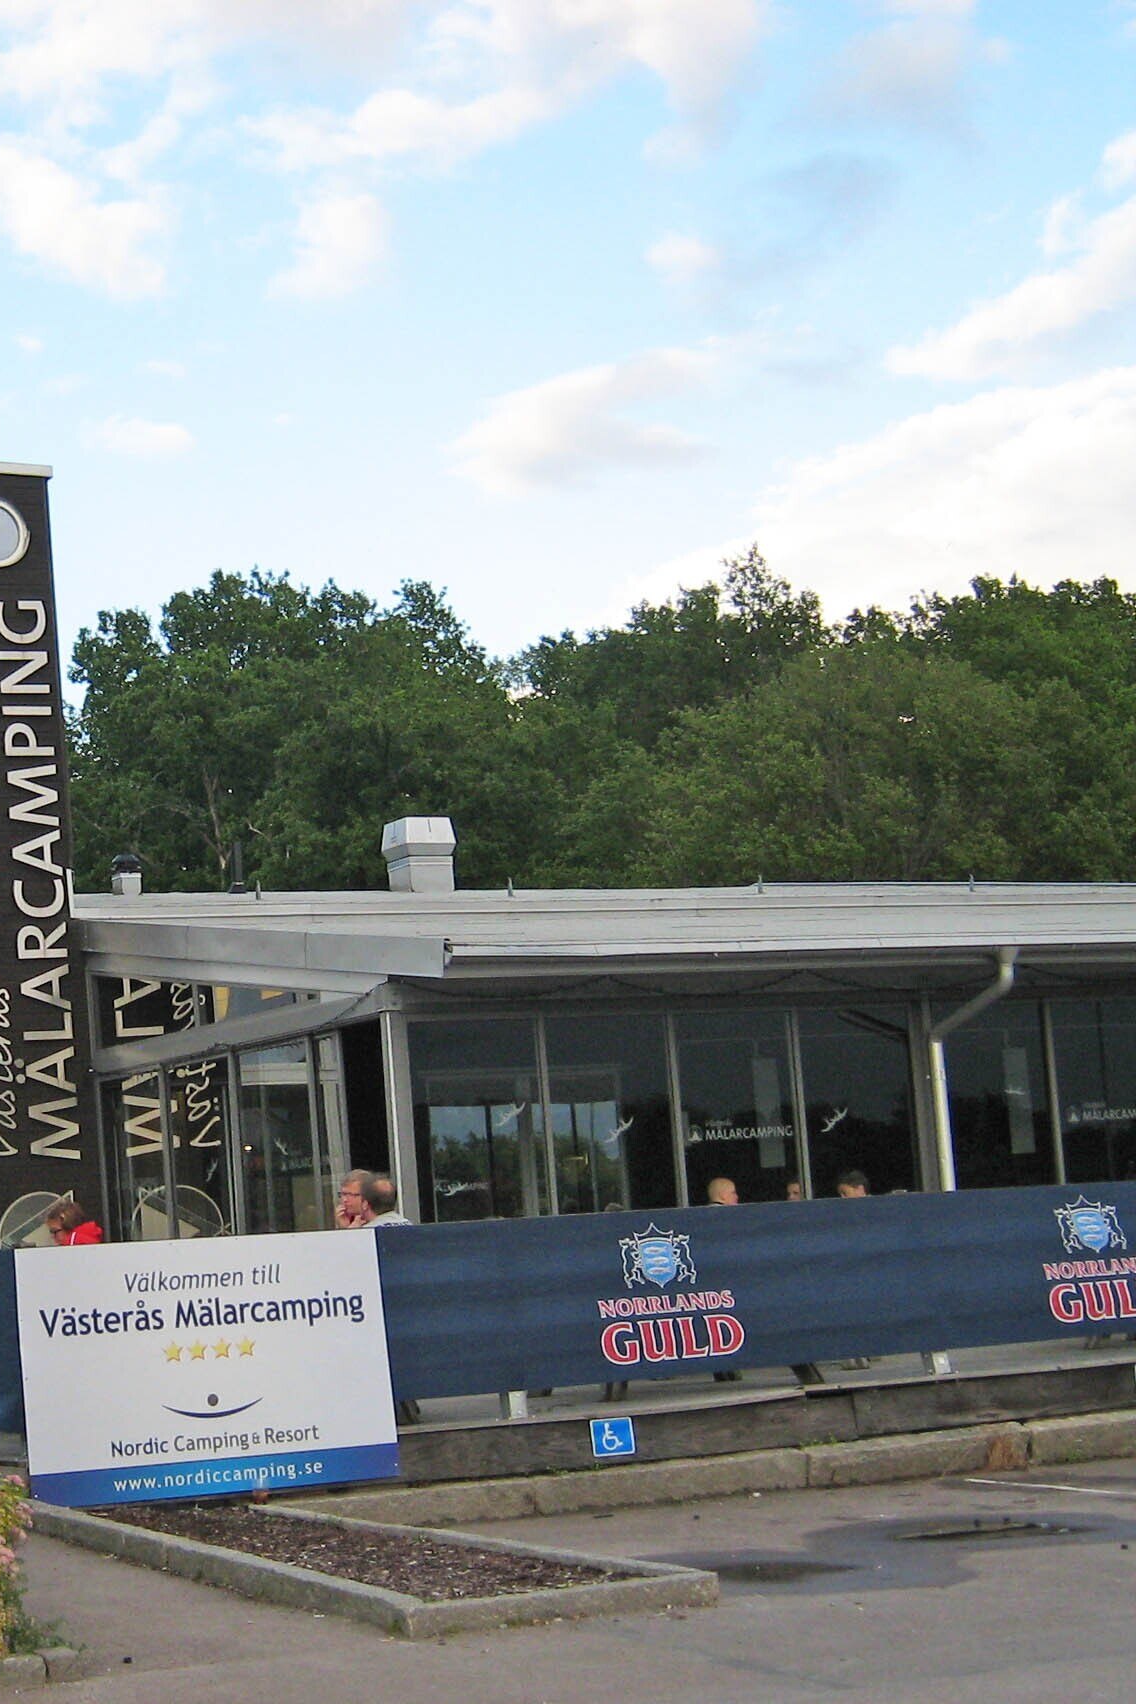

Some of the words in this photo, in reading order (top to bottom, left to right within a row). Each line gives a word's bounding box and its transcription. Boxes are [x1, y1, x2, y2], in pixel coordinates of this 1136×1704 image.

[124, 1270, 244, 1294] Välkommen
[251, 1263, 281, 1286] till
[38, 1299, 165, 1339] Västerås
[174, 1290, 366, 1329] Mälarcamping
[597, 1289, 736, 1319] NORRLANDS
[601, 1313, 745, 1366] GULD
[110, 1437, 169, 1458] Nordic
[173, 1431, 250, 1453] Camping
[252, 1431, 261, 1445] &
[264, 1424, 320, 1445] Resort
[113, 1460, 324, 1492] www.nordiccamping.se
